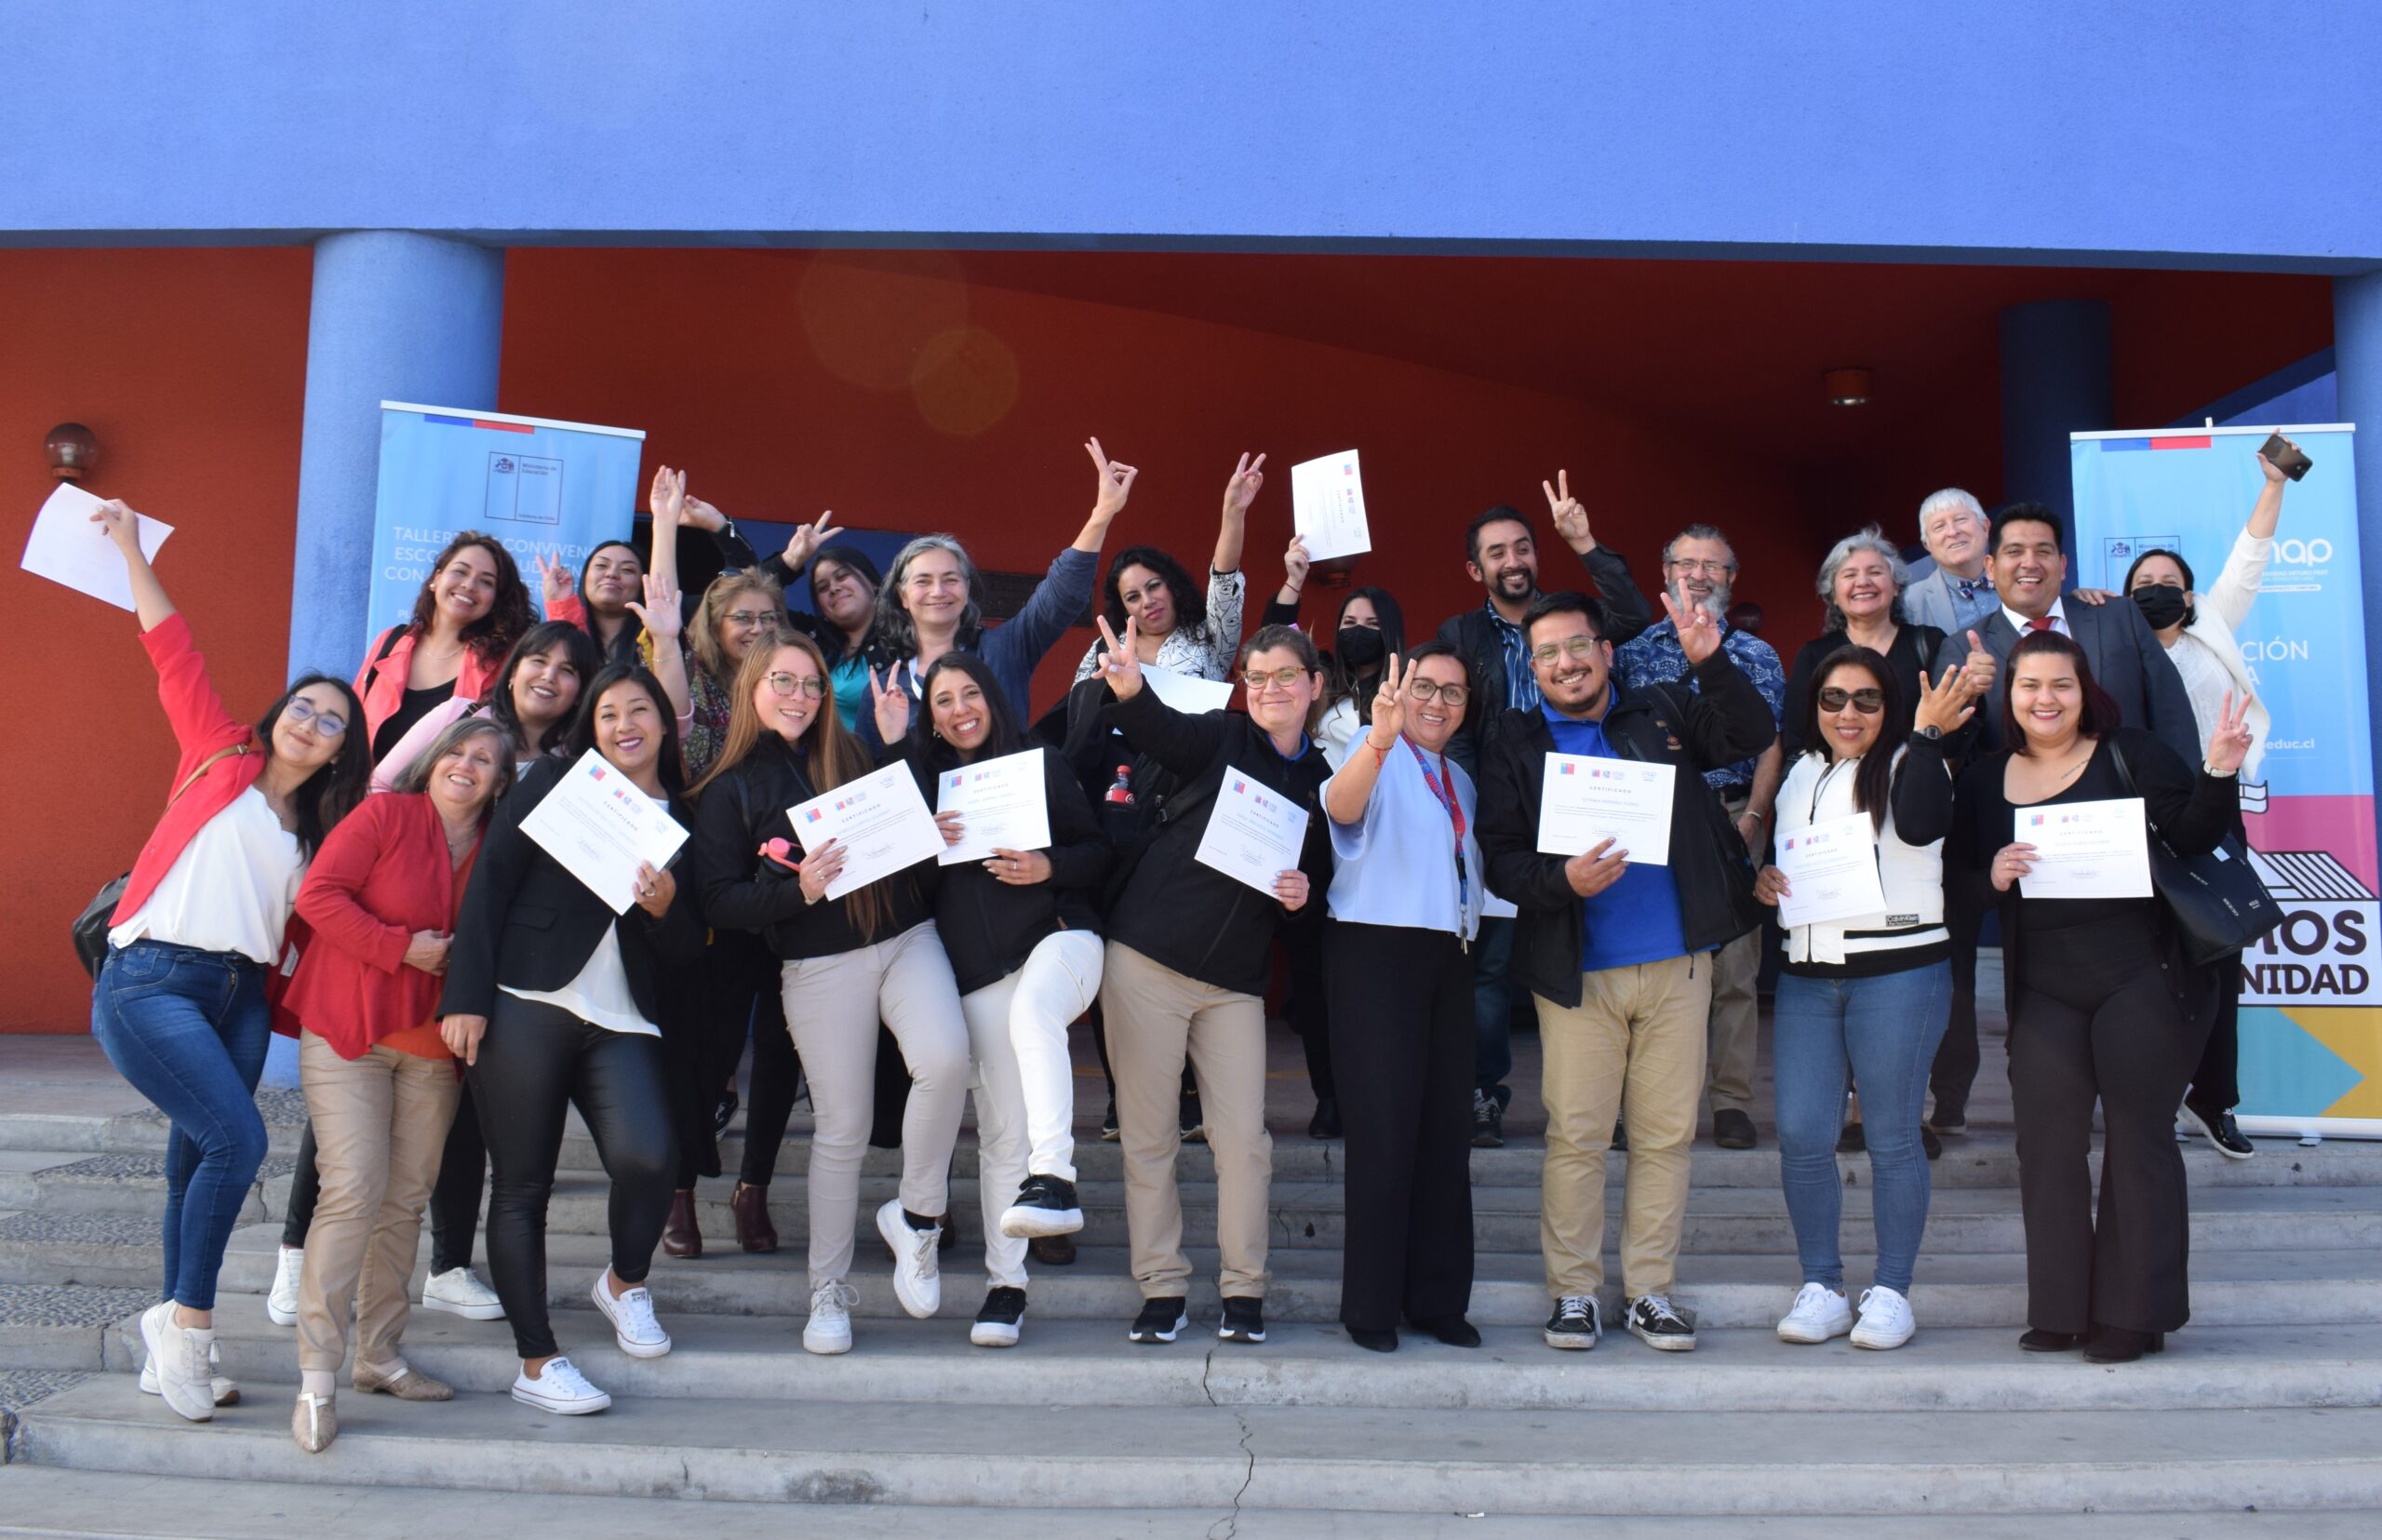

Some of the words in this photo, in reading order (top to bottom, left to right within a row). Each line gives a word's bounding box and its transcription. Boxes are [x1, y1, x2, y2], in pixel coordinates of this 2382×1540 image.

[2240, 635, 2308, 662] CIÓN
[2265, 738, 2315, 750] educ.cl
[2262, 909, 2367, 956] OS
[2238, 963, 2370, 995] NIDAD
